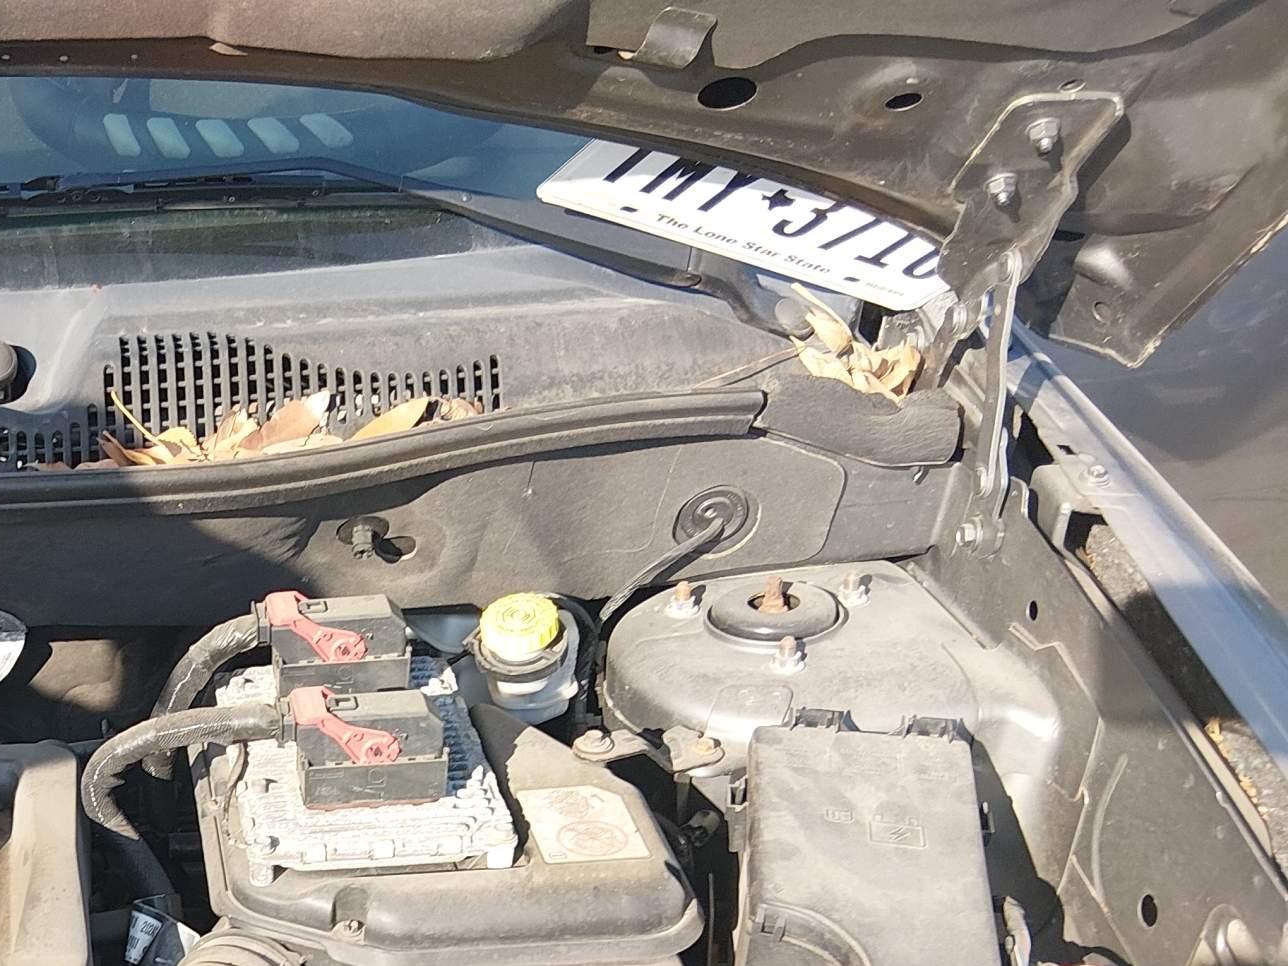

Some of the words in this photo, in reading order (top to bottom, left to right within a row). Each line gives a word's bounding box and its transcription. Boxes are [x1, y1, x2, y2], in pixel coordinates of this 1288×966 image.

[656, 213, 690, 230] The
[693, 225, 739, 246] Lone
[741, 241, 782, 259] Star
[783, 254, 833, 275] State
